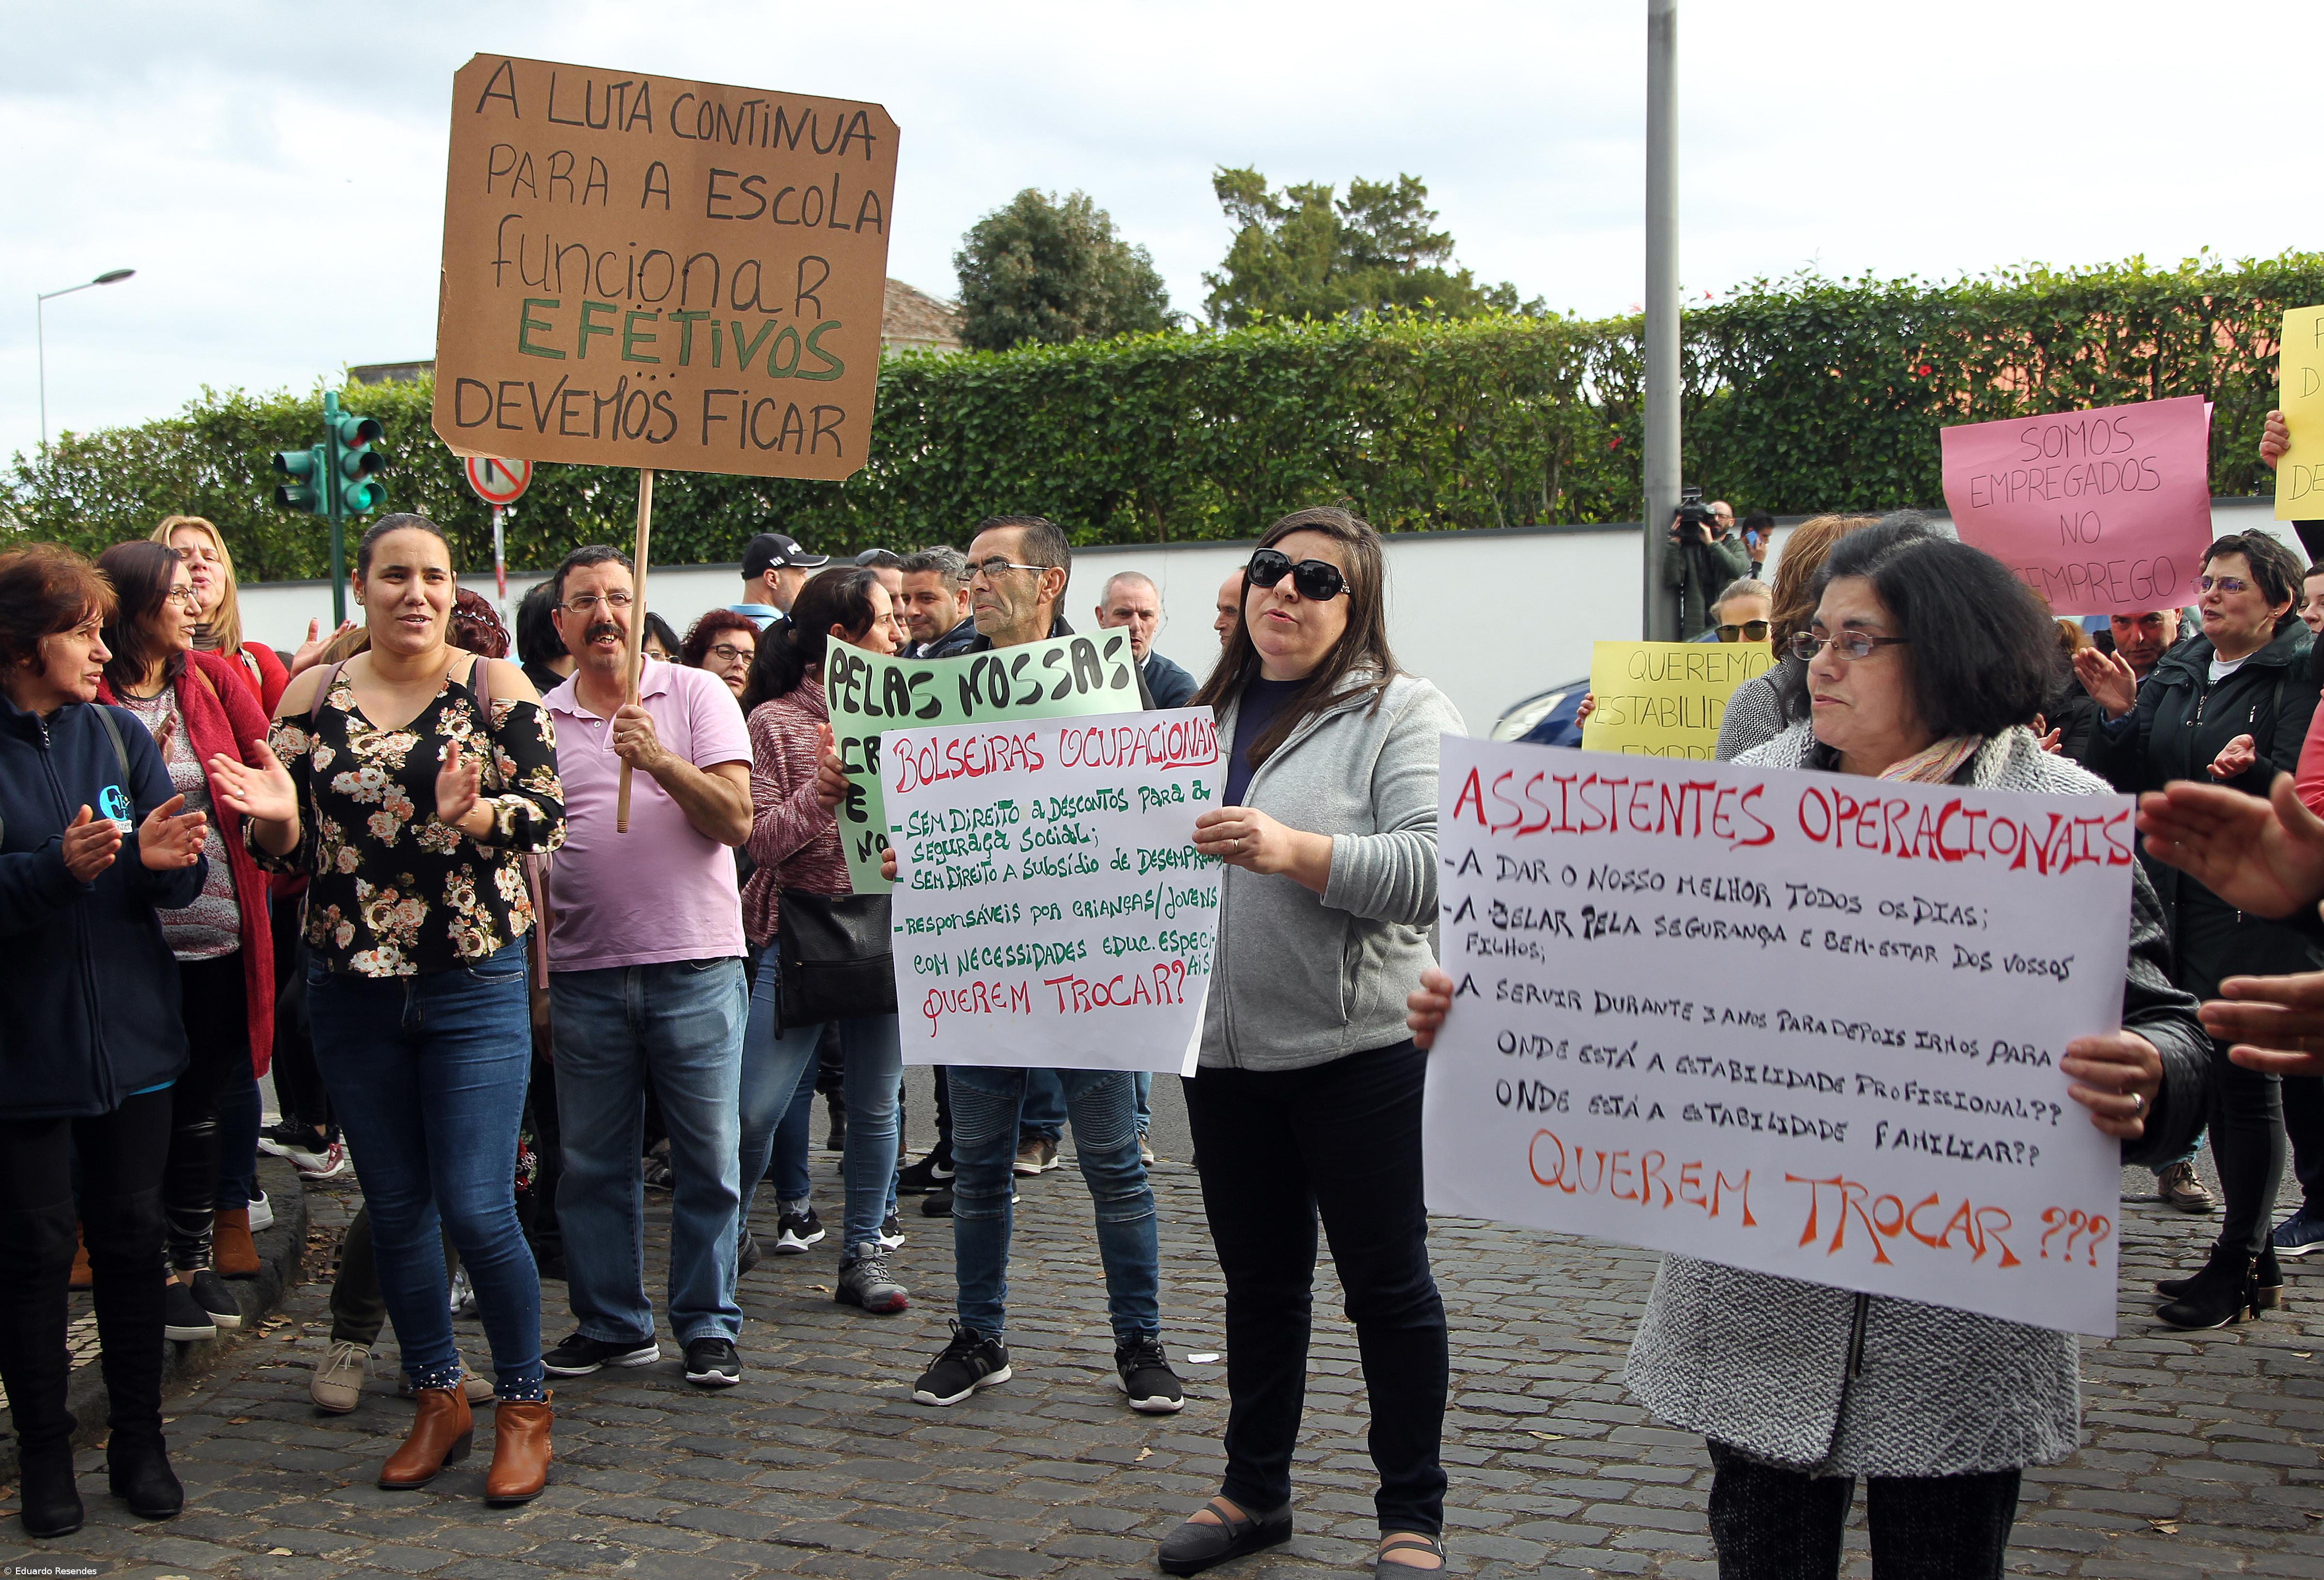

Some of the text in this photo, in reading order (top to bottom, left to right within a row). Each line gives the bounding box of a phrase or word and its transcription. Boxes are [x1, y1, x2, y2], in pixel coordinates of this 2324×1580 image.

[475, 61, 520, 120] A
[547, 71, 653, 134] LUTA
[487, 143, 883, 236] PARA A ESCOLA
[455, 374, 678, 444] DEVEMOS
[2021, 416, 2134, 462] SOMOS
[1971, 456, 2161, 508] EMPREGADOS
[2061, 511, 2101, 546] NO
[2011, 556, 2176, 604] EMPREGO
[830, 635, 1130, 719] PELAS NOSSAS
[1628, 651, 1777, 682] QUEREMO
[846, 782, 868, 823] E
[906, 810, 946, 840] SEM
[1048, 788, 1129, 824] DESCONTOS
[1453, 765, 2133, 876] ASSISTENTES OPERACIONAIS
[911, 869, 944, 890] SEM
[1003, 864, 1017, 882] A
[1496, 854, 1550, 886] DAR
[1562, 865, 1577, 887] O
[1588, 864, 1665, 892] NOSSO
[1677, 874, 1772, 908] MELHOR
[1786, 882, 1863, 913] TODOS
[914, 952, 949, 977] COM
[1466, 932, 1546, 964] FILHOS;
[1581, 904, 1641, 941] PELA
[1655, 914, 1788, 949] SEGURANÇA
[1801, 929, 1812, 948] E
[1824, 930, 1939, 963] BEM-ESTAR
[1952, 943, 1993, 972] DOS
[2003, 953, 2076, 983] VOSSOS
[922, 959, 1186, 1038] QUEREM TROCAR?
[1456, 973, 1480, 998] A
[1496, 978, 1582, 1012] SERVIR
[1595, 989, 1694, 1022] DURANTE
[1721, 1007, 1768, 1029] ANOS
[1987, 1040, 2051, 1066] PARA
[1497, 1030, 1569, 1060] ONDE
[1579, 1040, 1638, 1069] ESTÁ
[1646, 1052, 1665, 1073] A
[1496, 1079, 1570, 1112] ONDE
[1589, 1094, 1639, 1119] ESTÁ
[1648, 1103, 1666, 1121] A
[1529, 1128, 1758, 1228] QUEREM
[1785, 1171, 2022, 1269] TROCAR
